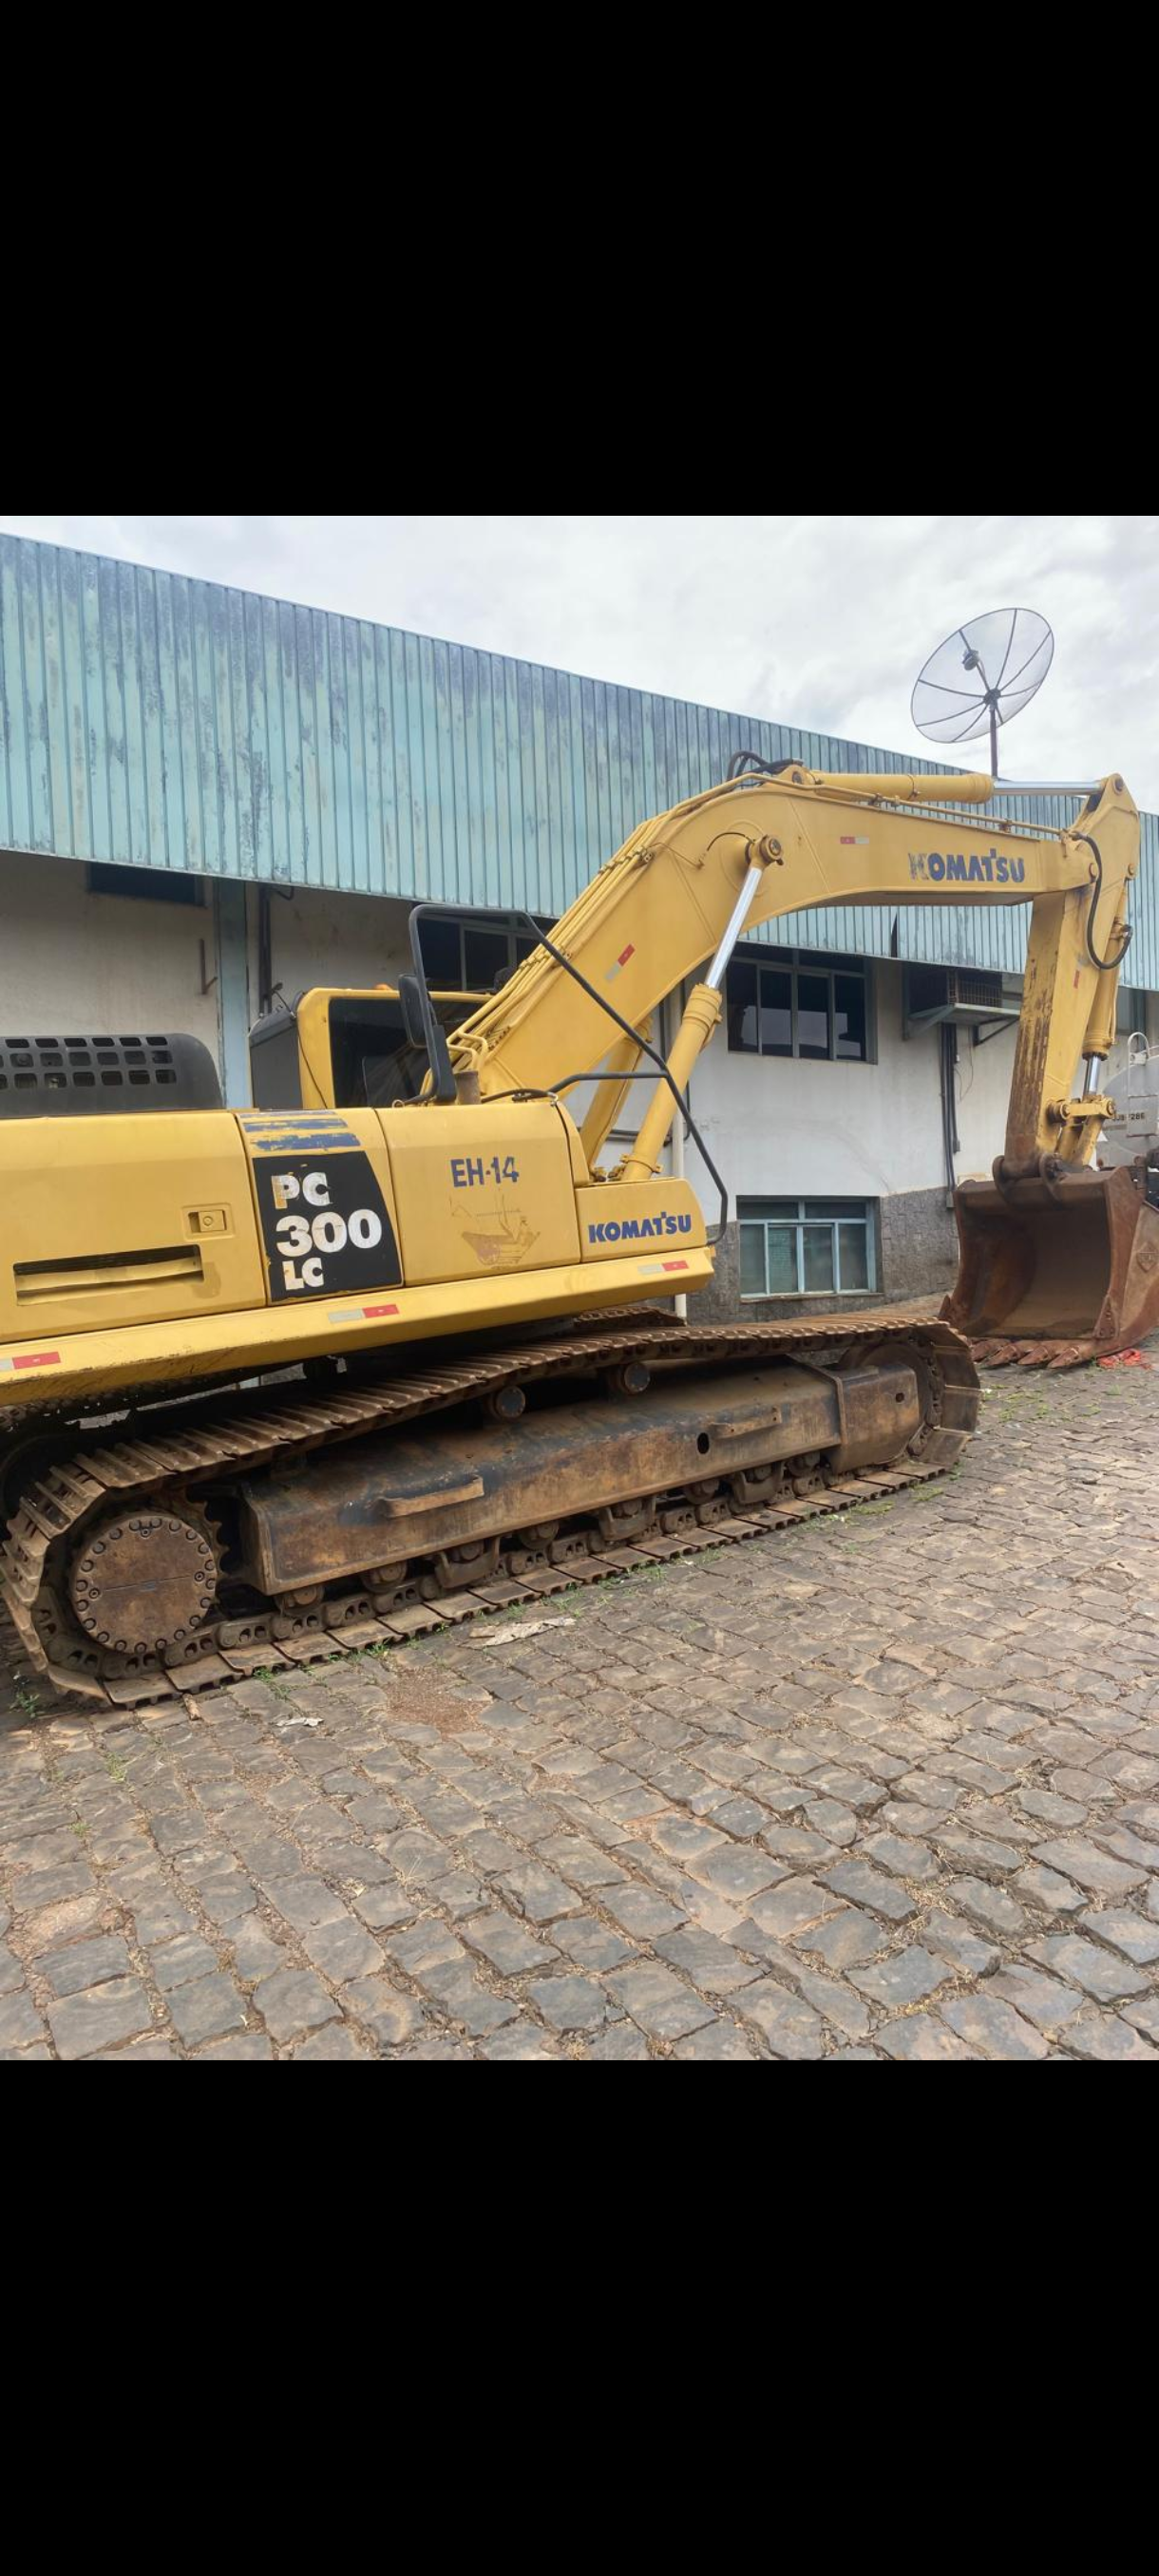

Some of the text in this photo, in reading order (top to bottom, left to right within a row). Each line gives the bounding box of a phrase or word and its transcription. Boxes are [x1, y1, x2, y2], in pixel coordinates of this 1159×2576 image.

[271, 1171, 332, 1210] PC
[276, 1208, 383, 1258] 300
[587, 1211, 693, 1244] KOMATSU
[282, 1257, 325, 1291] LC
